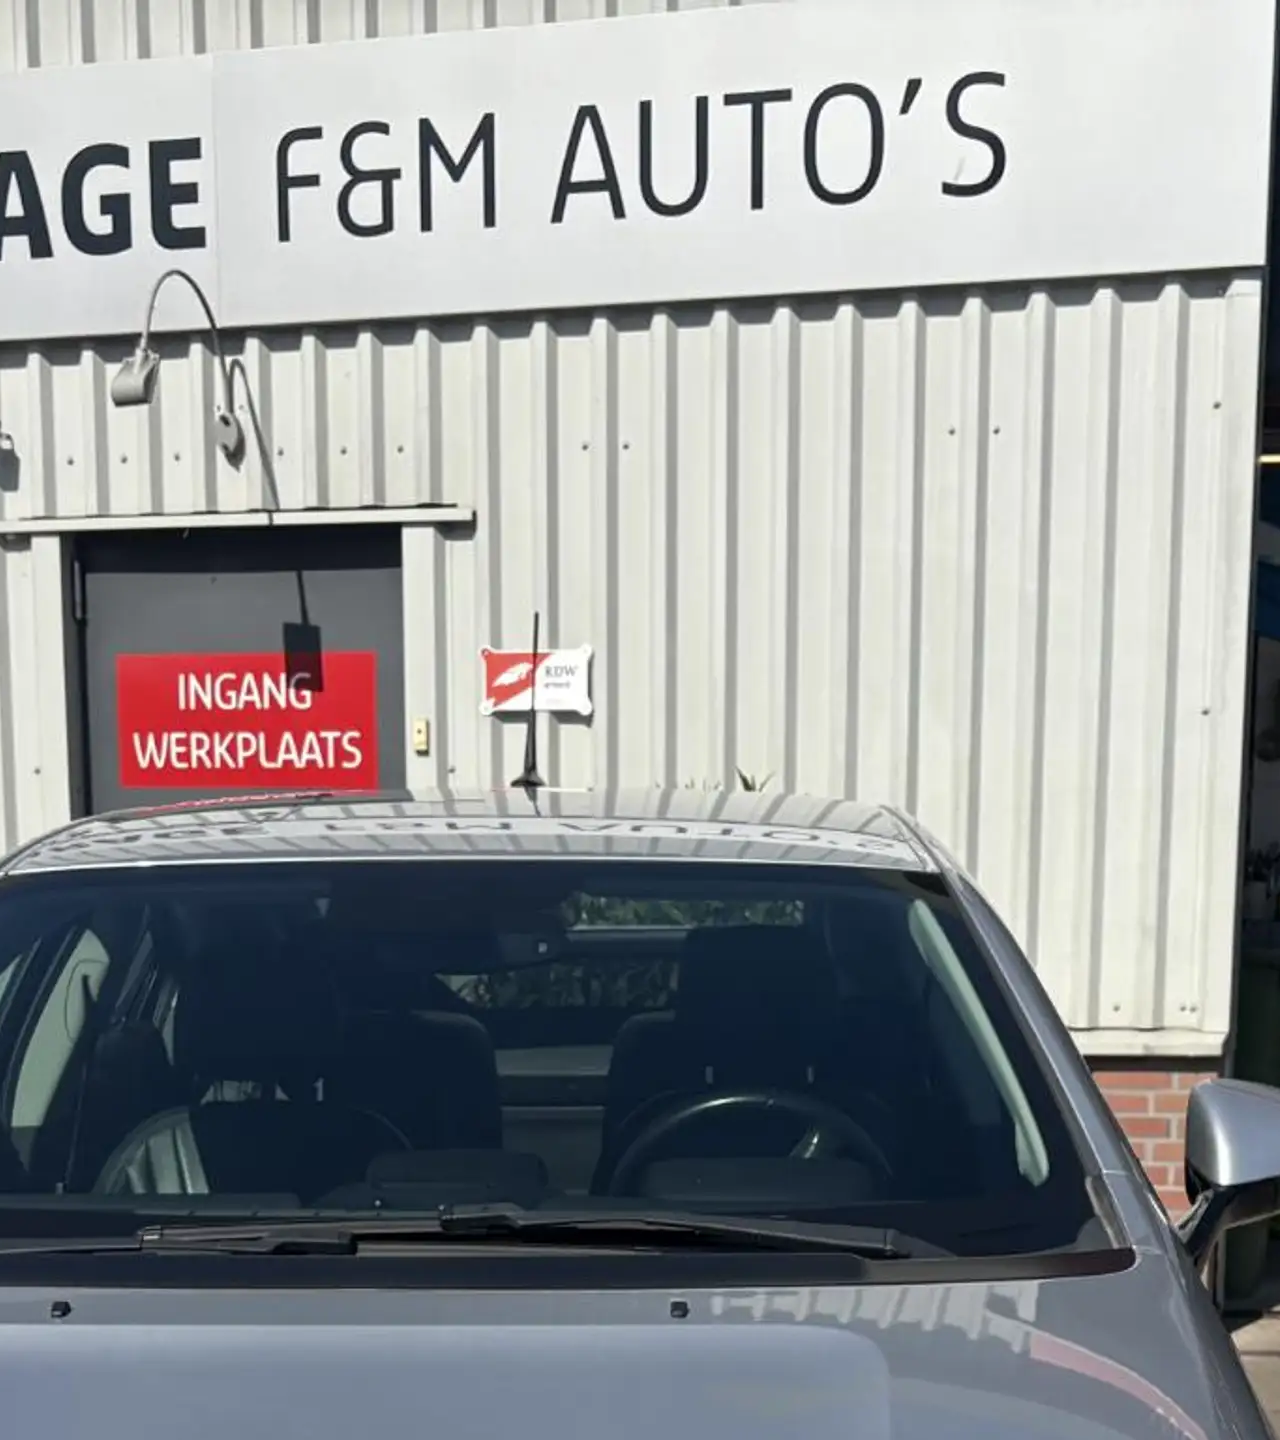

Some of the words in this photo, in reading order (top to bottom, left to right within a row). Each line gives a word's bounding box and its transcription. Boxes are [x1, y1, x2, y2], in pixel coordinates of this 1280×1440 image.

[275, 112, 496, 243] F&M
[550, 71, 1006, 224] AUTO'S
[178, 672, 313, 711] INGANG
[133, 730, 363, 769] WERKPLAATS
